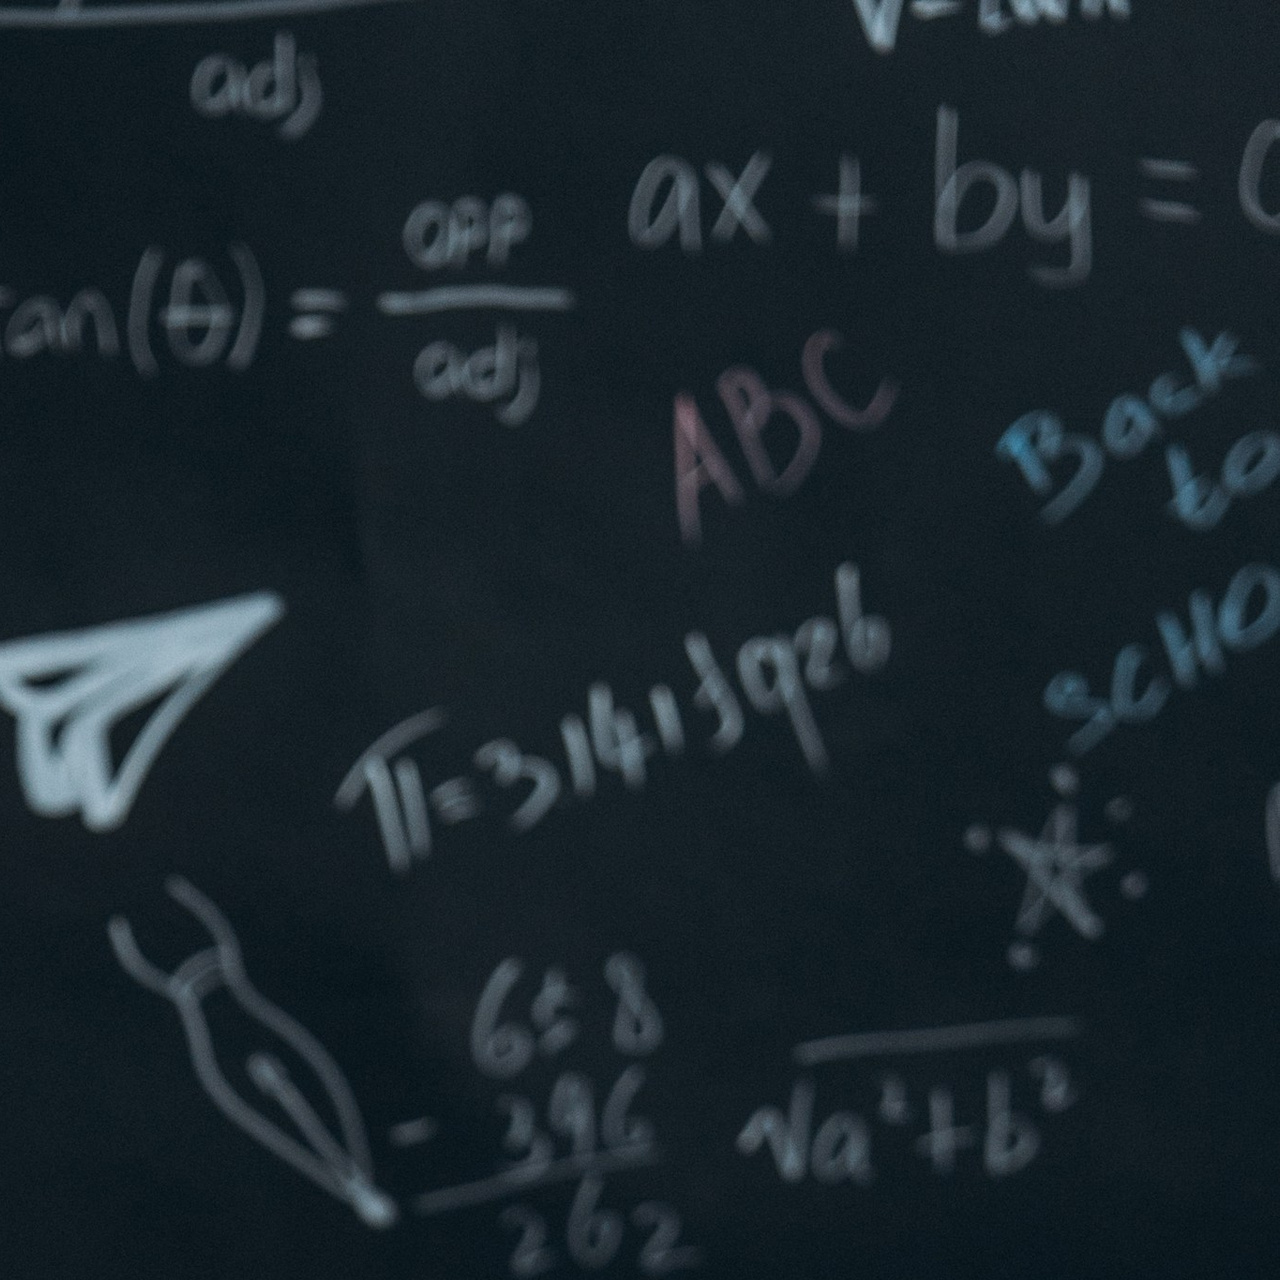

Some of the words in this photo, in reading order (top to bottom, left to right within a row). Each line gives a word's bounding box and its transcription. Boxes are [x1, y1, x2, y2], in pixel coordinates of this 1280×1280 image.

[190, 30, 322, 140] adj
[628, 152, 770, 250] ax
[933, 104, 1093, 285] by
[413, 327, 540, 426] adj
[672, 330, 901, 548] ABC
[500, 1166, 700, 1278] 262
